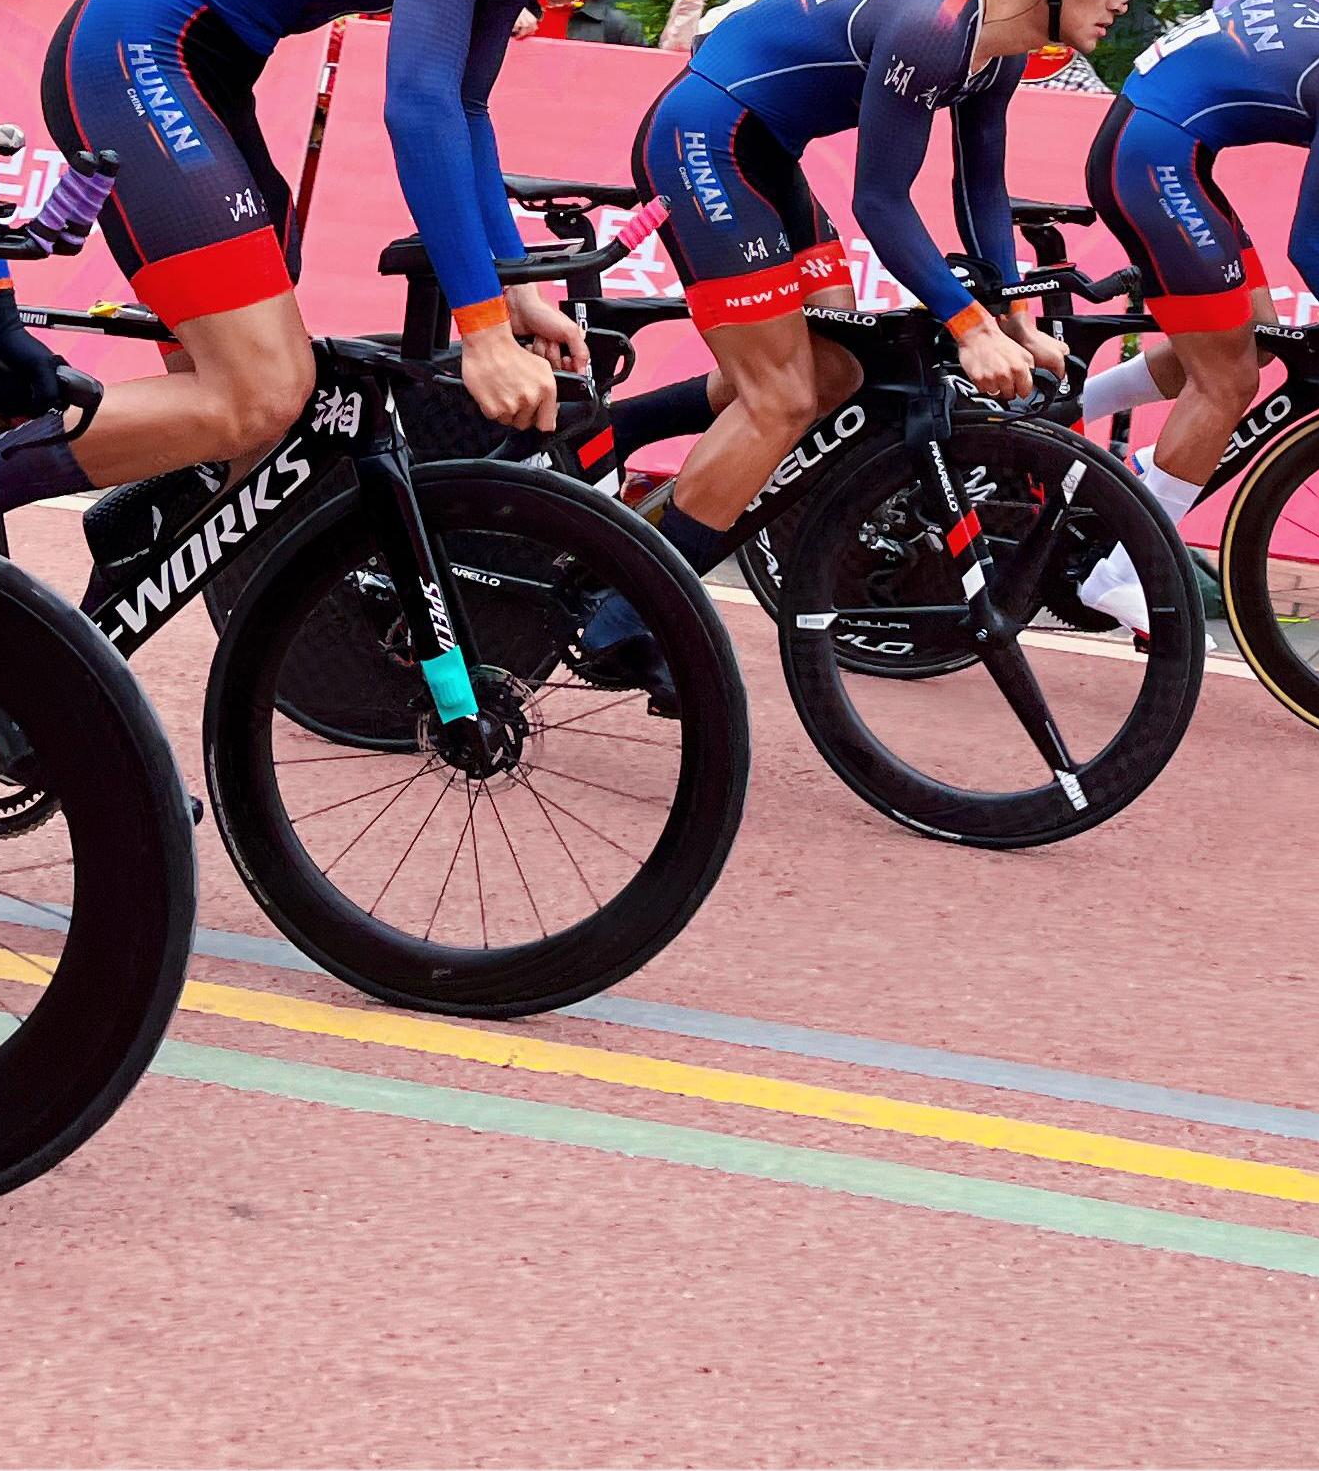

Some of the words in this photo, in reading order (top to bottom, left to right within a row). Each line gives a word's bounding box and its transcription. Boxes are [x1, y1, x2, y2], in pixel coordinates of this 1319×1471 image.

[126, 42, 202, 153] HUNAN
[126, 86, 147, 118] CHINA
[683, 130, 734, 223] HUNAN
[1156, 165, 1216, 249] HUNAN
[725, 290, 773, 309] NEW
[1000, 278, 1060, 297] aerocoach
[1254, 323, 1306, 341] RELLO
[311, 386, 363, 439] 湘
[928, 440, 960, 513] PINARELLO
[95, 436, 311, 643] -WORKS
[451, 566, 501, 587] ARELLO
